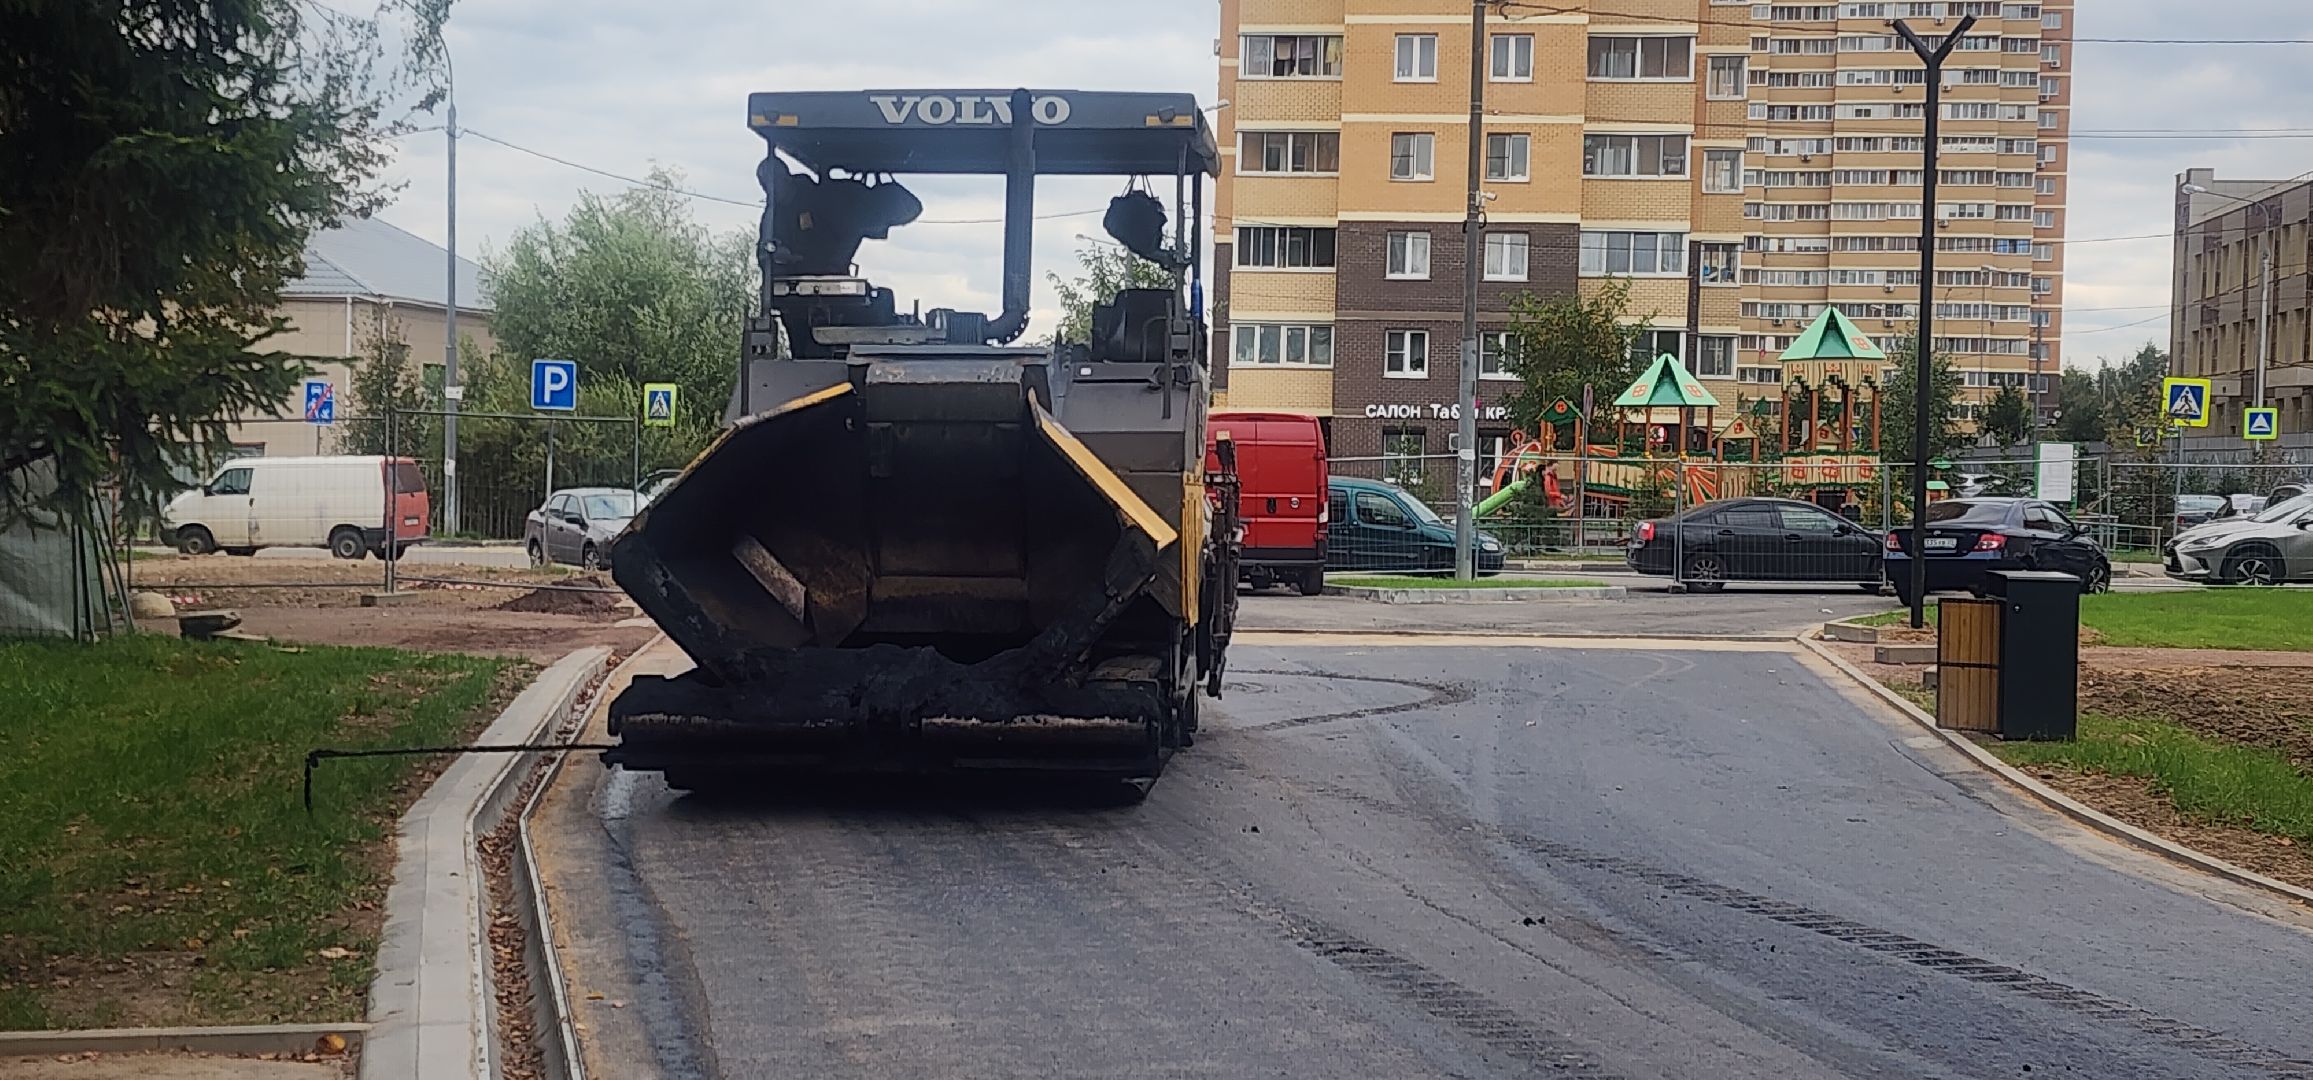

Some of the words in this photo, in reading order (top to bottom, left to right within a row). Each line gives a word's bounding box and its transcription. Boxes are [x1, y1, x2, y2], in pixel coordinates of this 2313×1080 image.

[870, 96, 1070, 124] VOLVO
[544, 366, 568, 403] P
[1365, 404, 1421, 419] САЛОН
